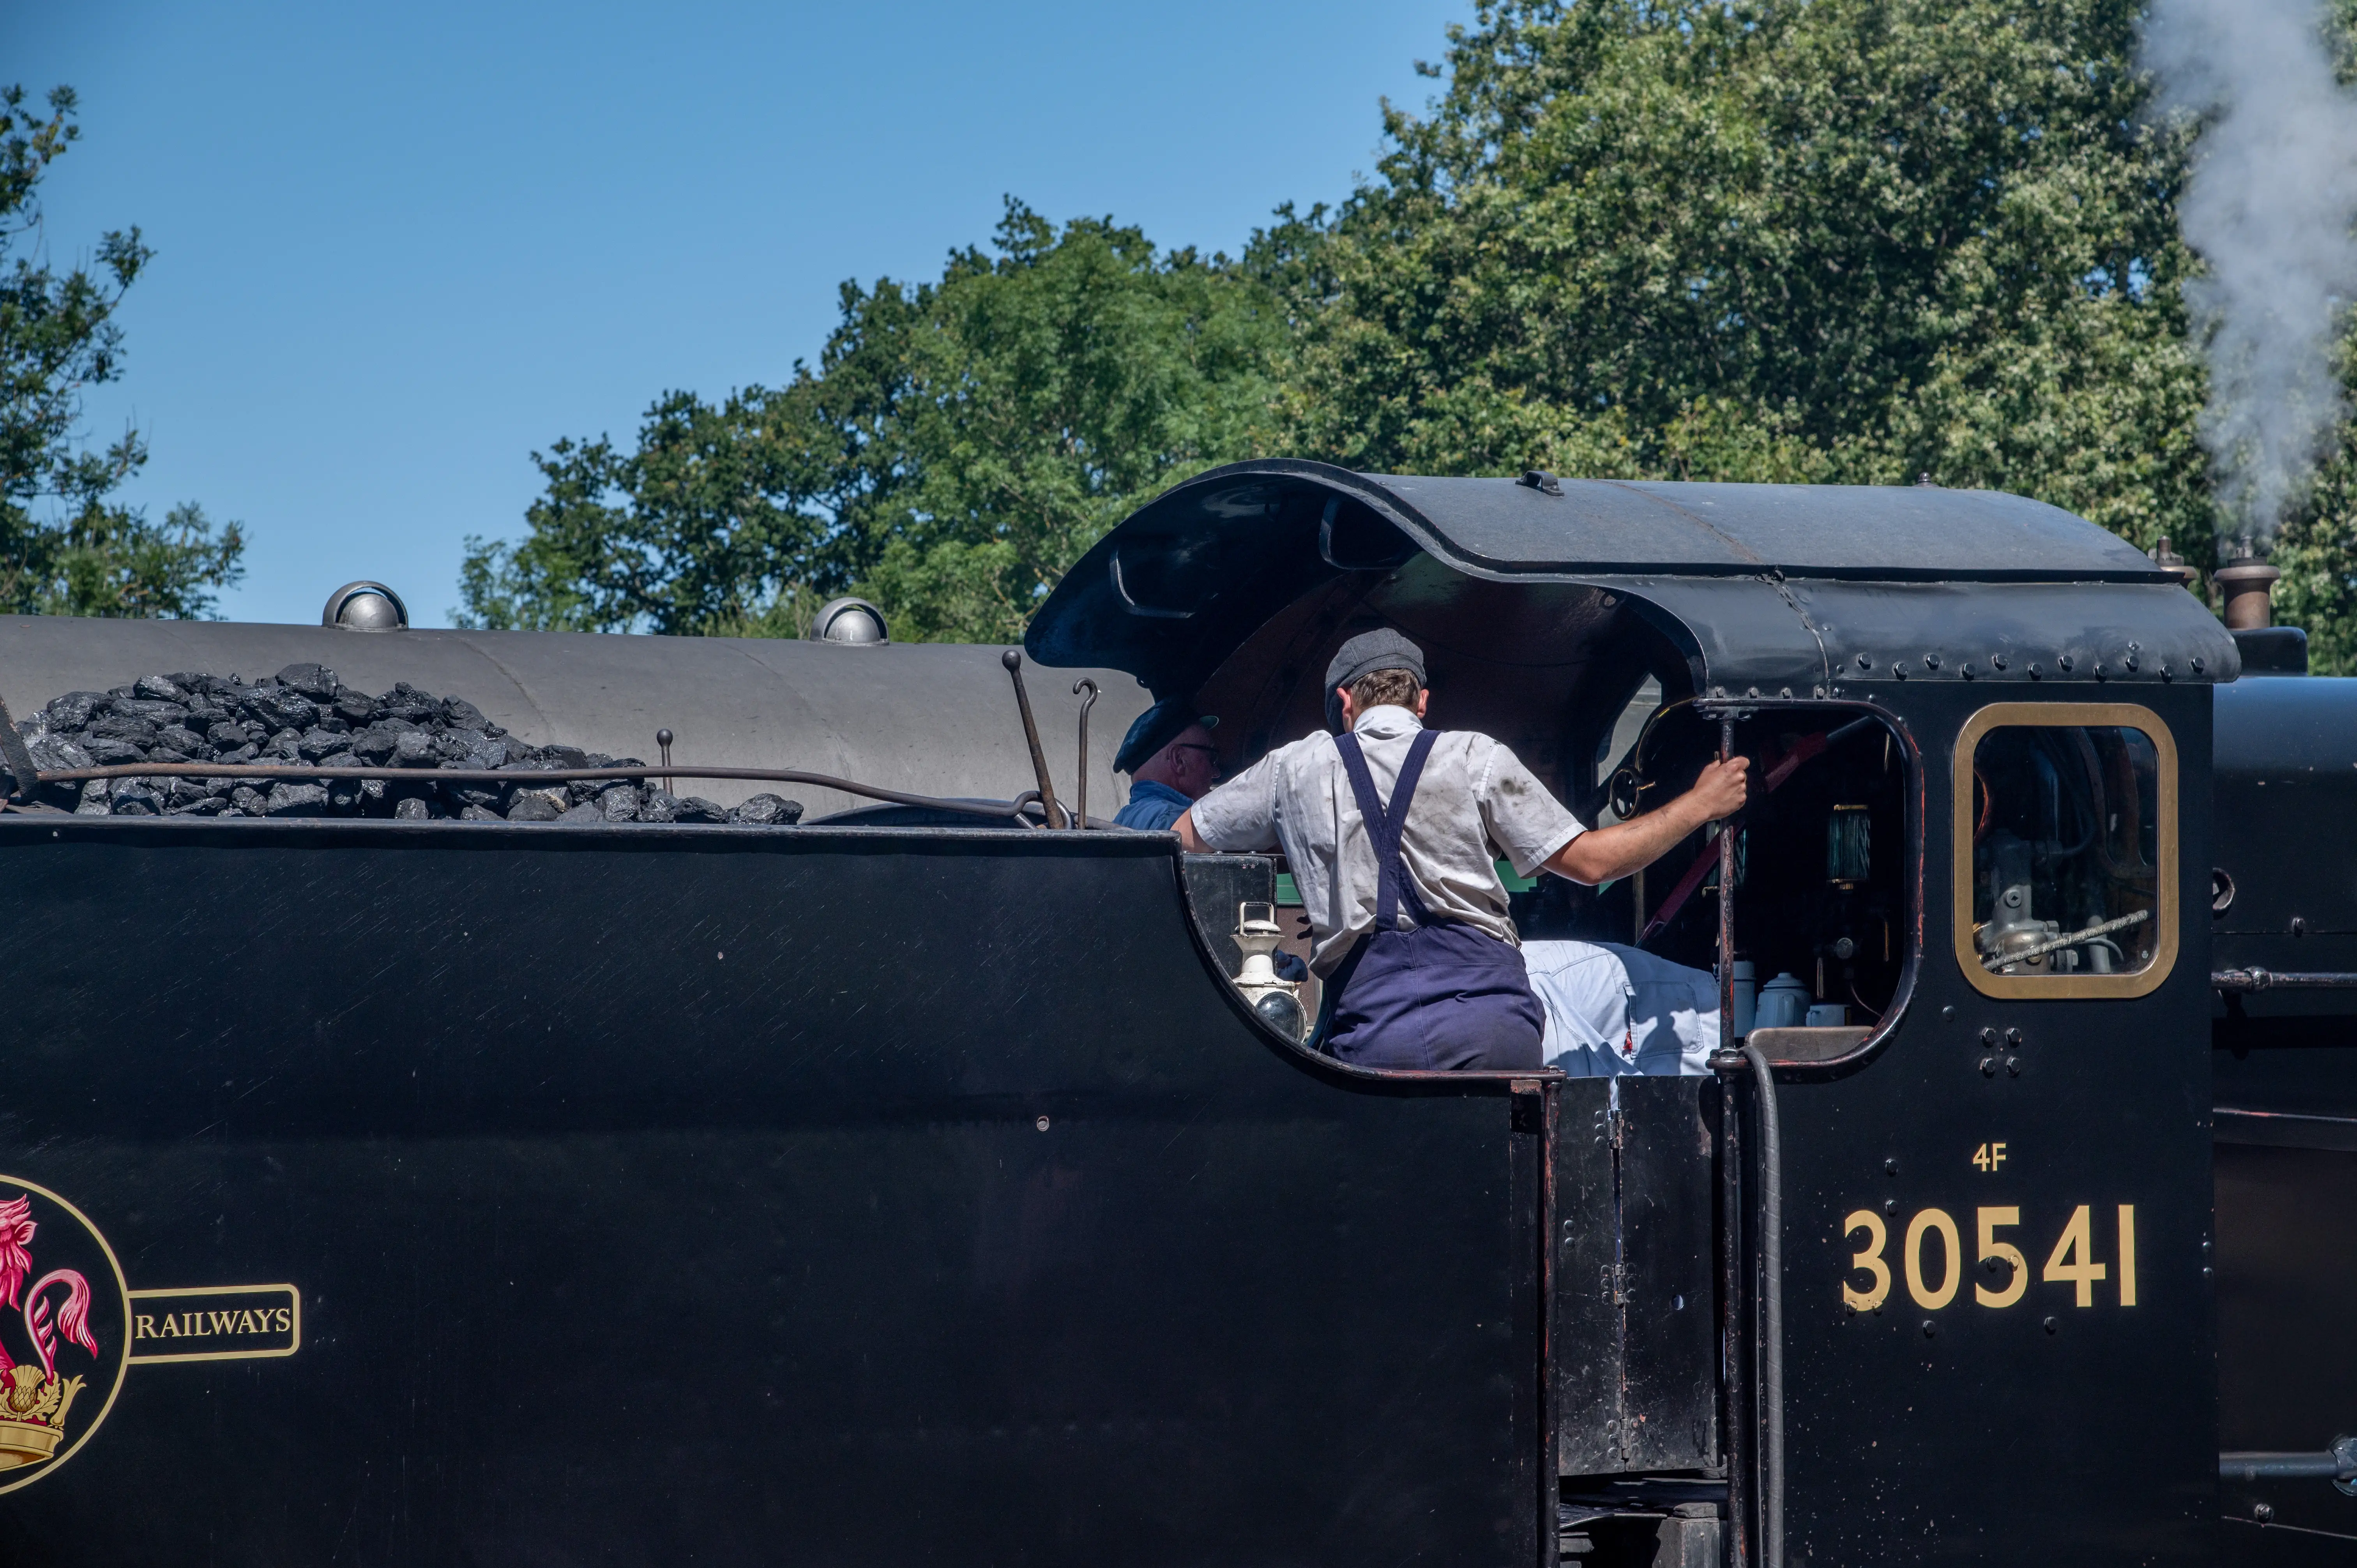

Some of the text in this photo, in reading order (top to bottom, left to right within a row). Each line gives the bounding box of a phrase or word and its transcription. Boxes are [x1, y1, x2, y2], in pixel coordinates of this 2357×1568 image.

[1973, 1143, 2006, 1172] 4F
[1843, 1204, 2136, 1312] 30541
[135, 1308, 291, 1338] RAILWAYS
